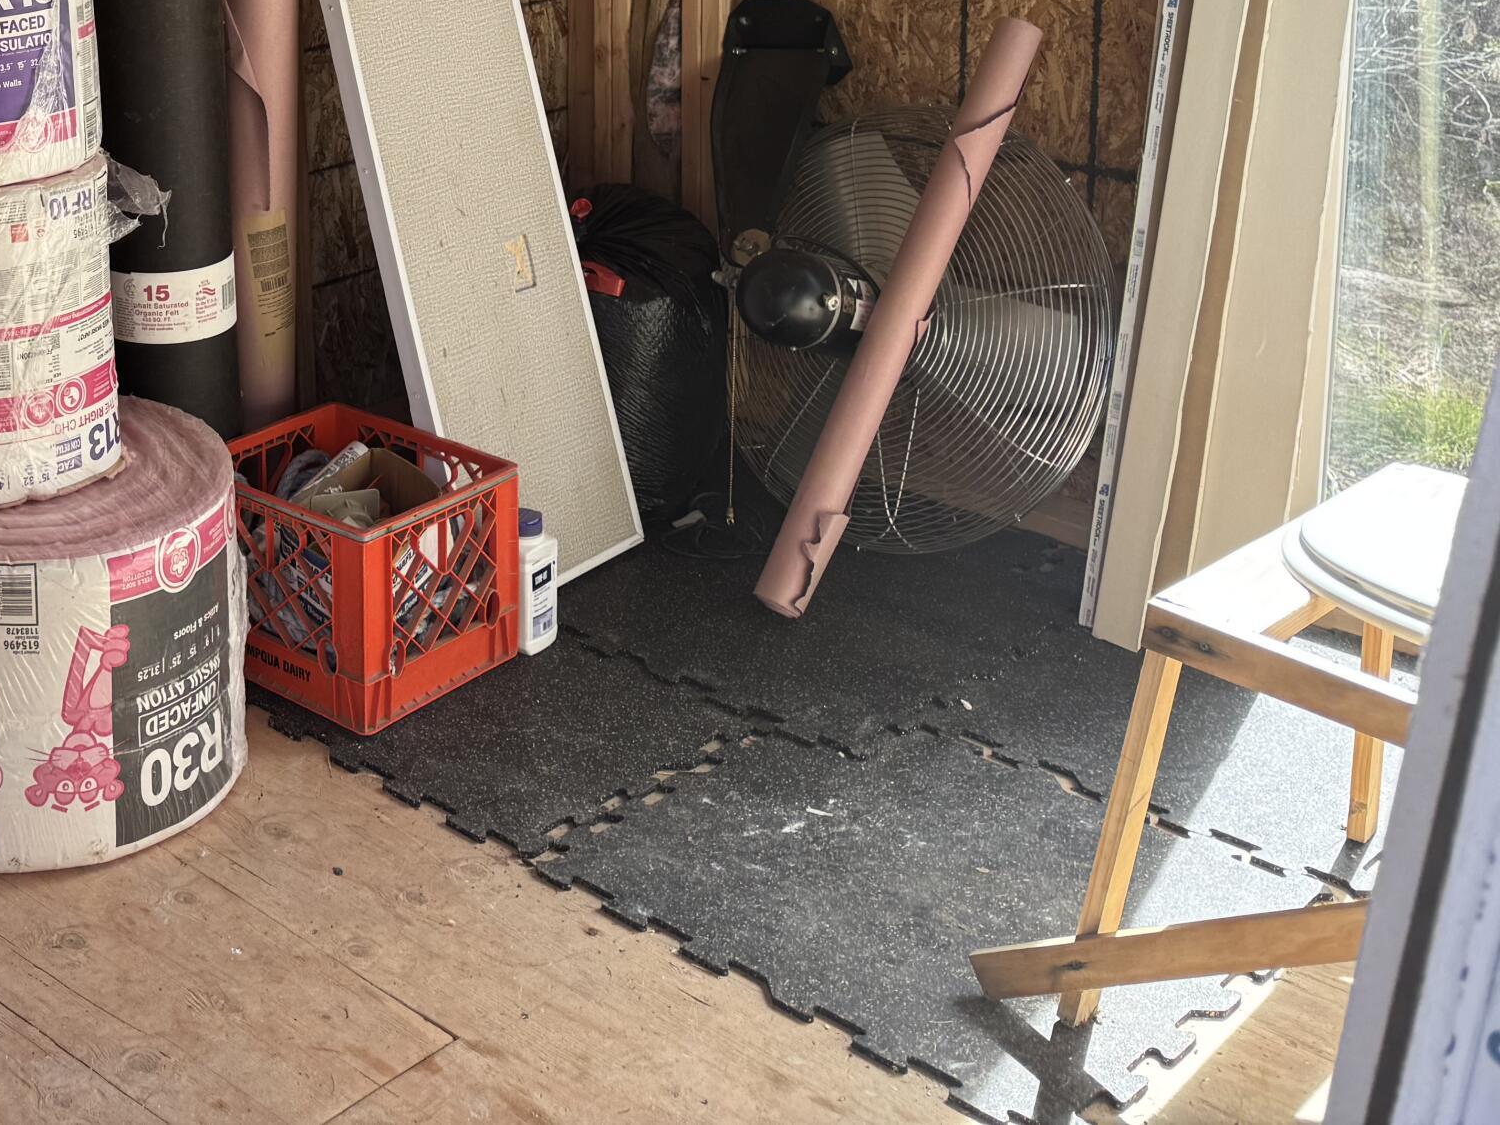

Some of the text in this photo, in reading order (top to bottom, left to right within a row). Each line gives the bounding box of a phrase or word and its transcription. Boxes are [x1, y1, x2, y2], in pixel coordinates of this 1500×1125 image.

[0, 14, 45, 34] FACED
[3, 79, 22, 89] Walls
[143, 284, 170, 302] 15
[133, 301, 189, 310] phalt Saturated
[135, 309, 162, 317] Organic
[54, 418, 77, 436] CHO
[78, 408, 104, 428] RIGHT
[56, 459, 76, 470] FAC
[173, 621, 198, 640] Floors
[3, 640, 40, 650] 615496
[137, 662, 161, 682] 31.25
[247, 647, 312, 683] MPQUA DAIRY
[135, 656, 220, 713] INSULATION
[145, 680, 218, 737] UNFACED
[140, 707, 224, 807] R30
